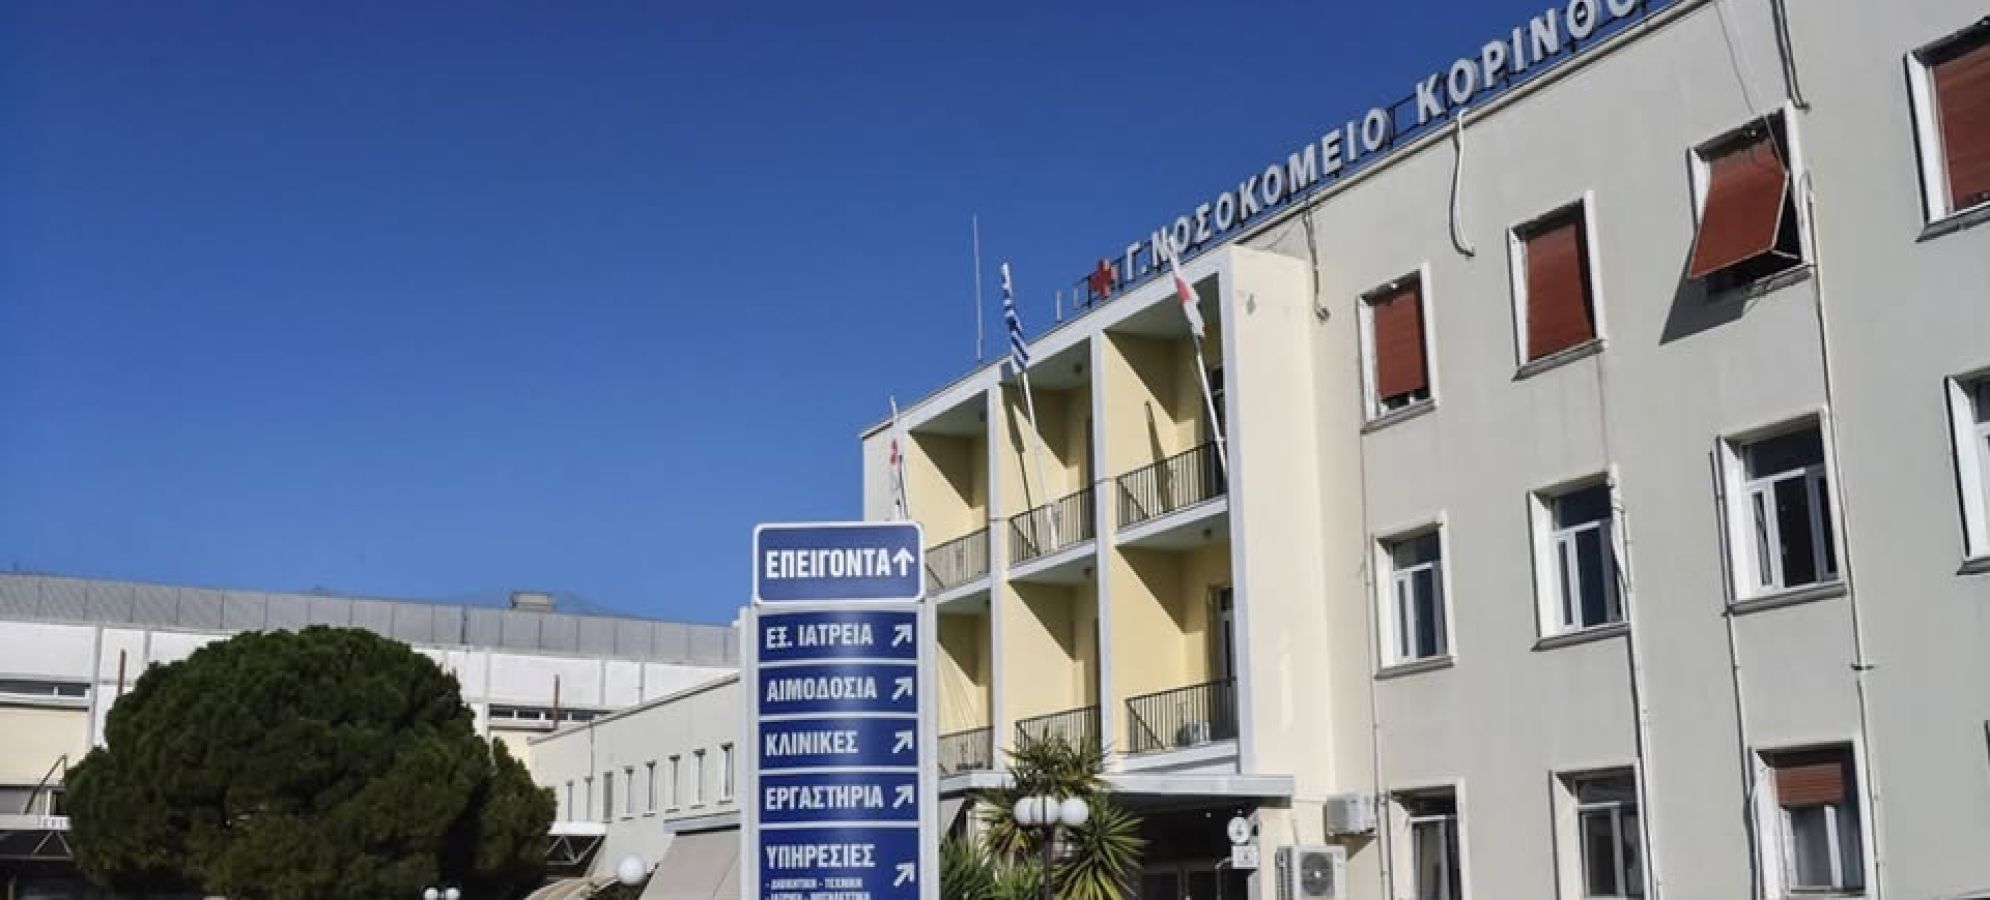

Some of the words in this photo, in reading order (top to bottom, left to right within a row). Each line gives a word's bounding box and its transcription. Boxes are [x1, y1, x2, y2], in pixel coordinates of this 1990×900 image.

[766, 548, 891, 578] ΕΠΕΙΓΟΝΤΑ
[766, 626, 792, 649] ΕΞ.
[798, 622, 873, 646] ΙΑΤΡΕΙΑ
[766, 676, 877, 702] ΑΙΜΟΔΟΣΙΑ
[766, 730, 859, 756] ΚΛΙΝΙΚΕΣ
[766, 784, 884, 811] ΕΡΓΑΣΤΗΡΙΑ
[766, 844, 876, 869] ΥΠΗΡΕΣΙΕΣ
